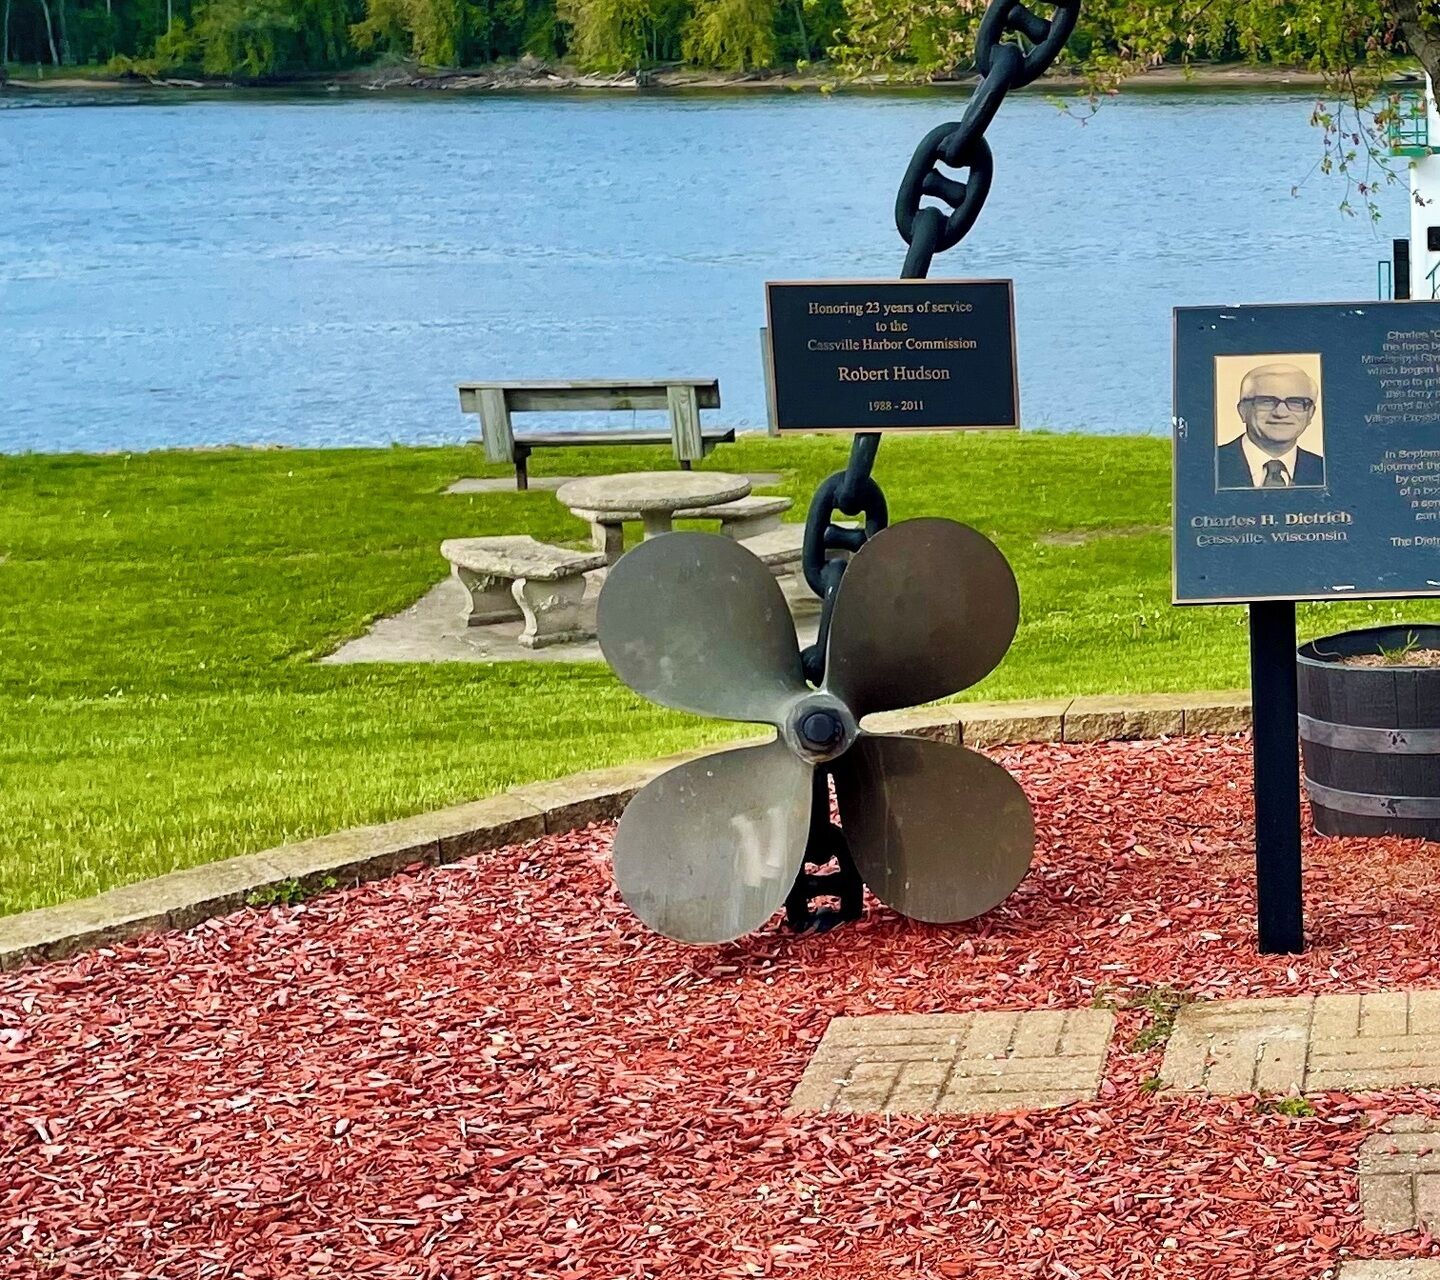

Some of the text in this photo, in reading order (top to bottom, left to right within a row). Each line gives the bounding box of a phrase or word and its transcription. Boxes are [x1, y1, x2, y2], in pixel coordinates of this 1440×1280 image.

[808, 300, 973, 317] Honoring 23 years of service
[875, 320, 908, 332] to the
[808, 337, 977, 351] Cassville Harbor Commission
[838, 365, 951, 382] Robert Hudson
[1400, 365, 1433, 376] began
[1412, 378, 1422, 386] to
[868, 401, 892, 412] 1988
[900, 400, 924, 411] 2011
[1385, 450, 1395, 458] In
[1396, 474, 1407, 485] by
[1190, 511, 1353, 528] Charles H. Dietrich
[1271, 530, 1347, 542] Wisconsin
[1390, 536, 1411, 546] The
